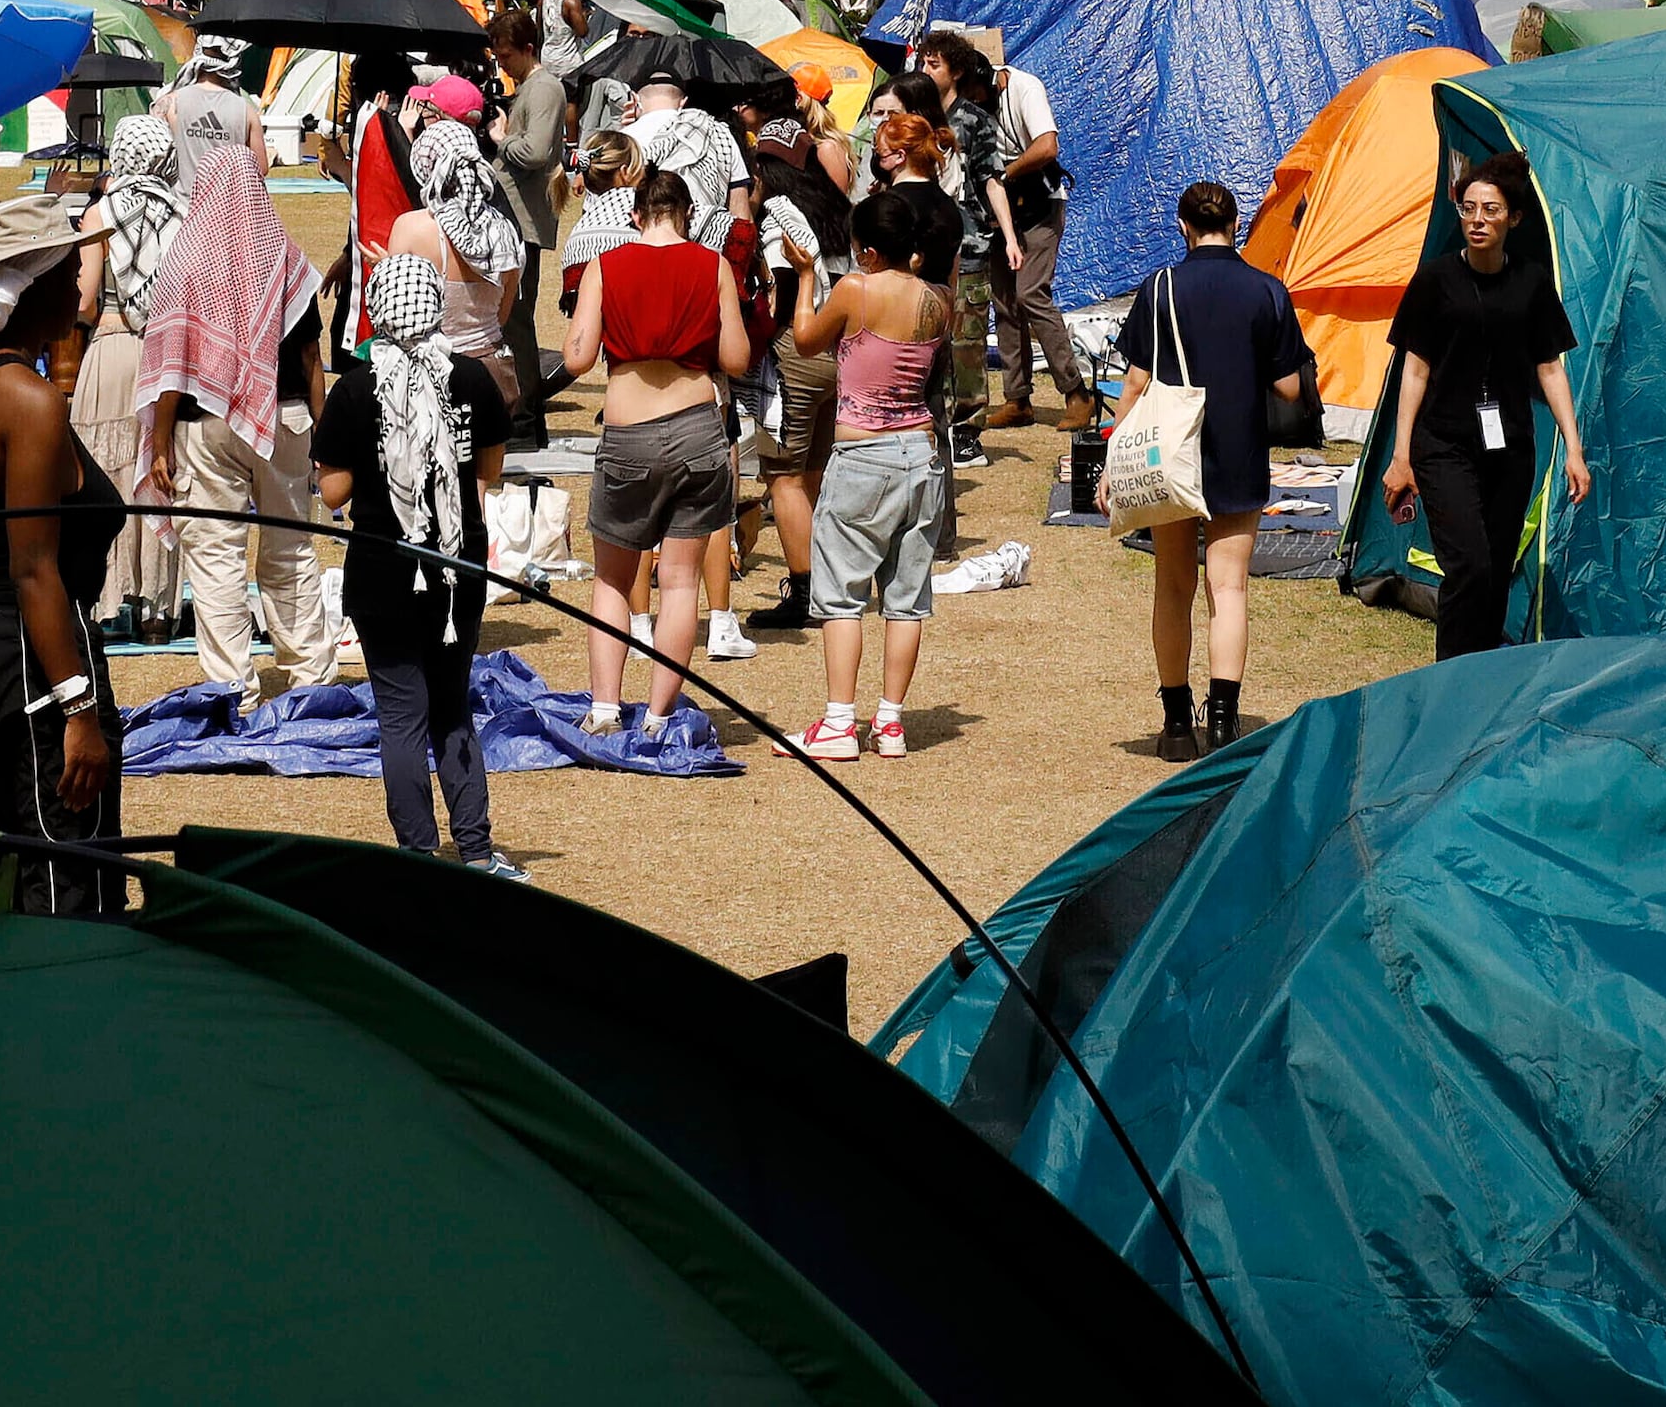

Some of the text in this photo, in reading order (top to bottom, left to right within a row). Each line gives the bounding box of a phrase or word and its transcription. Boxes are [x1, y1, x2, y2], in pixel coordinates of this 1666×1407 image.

[186, 127, 230, 141] adidas
[1112, 470, 1164, 493] SCIENCES
[1115, 487, 1169, 509] SOCIALES
